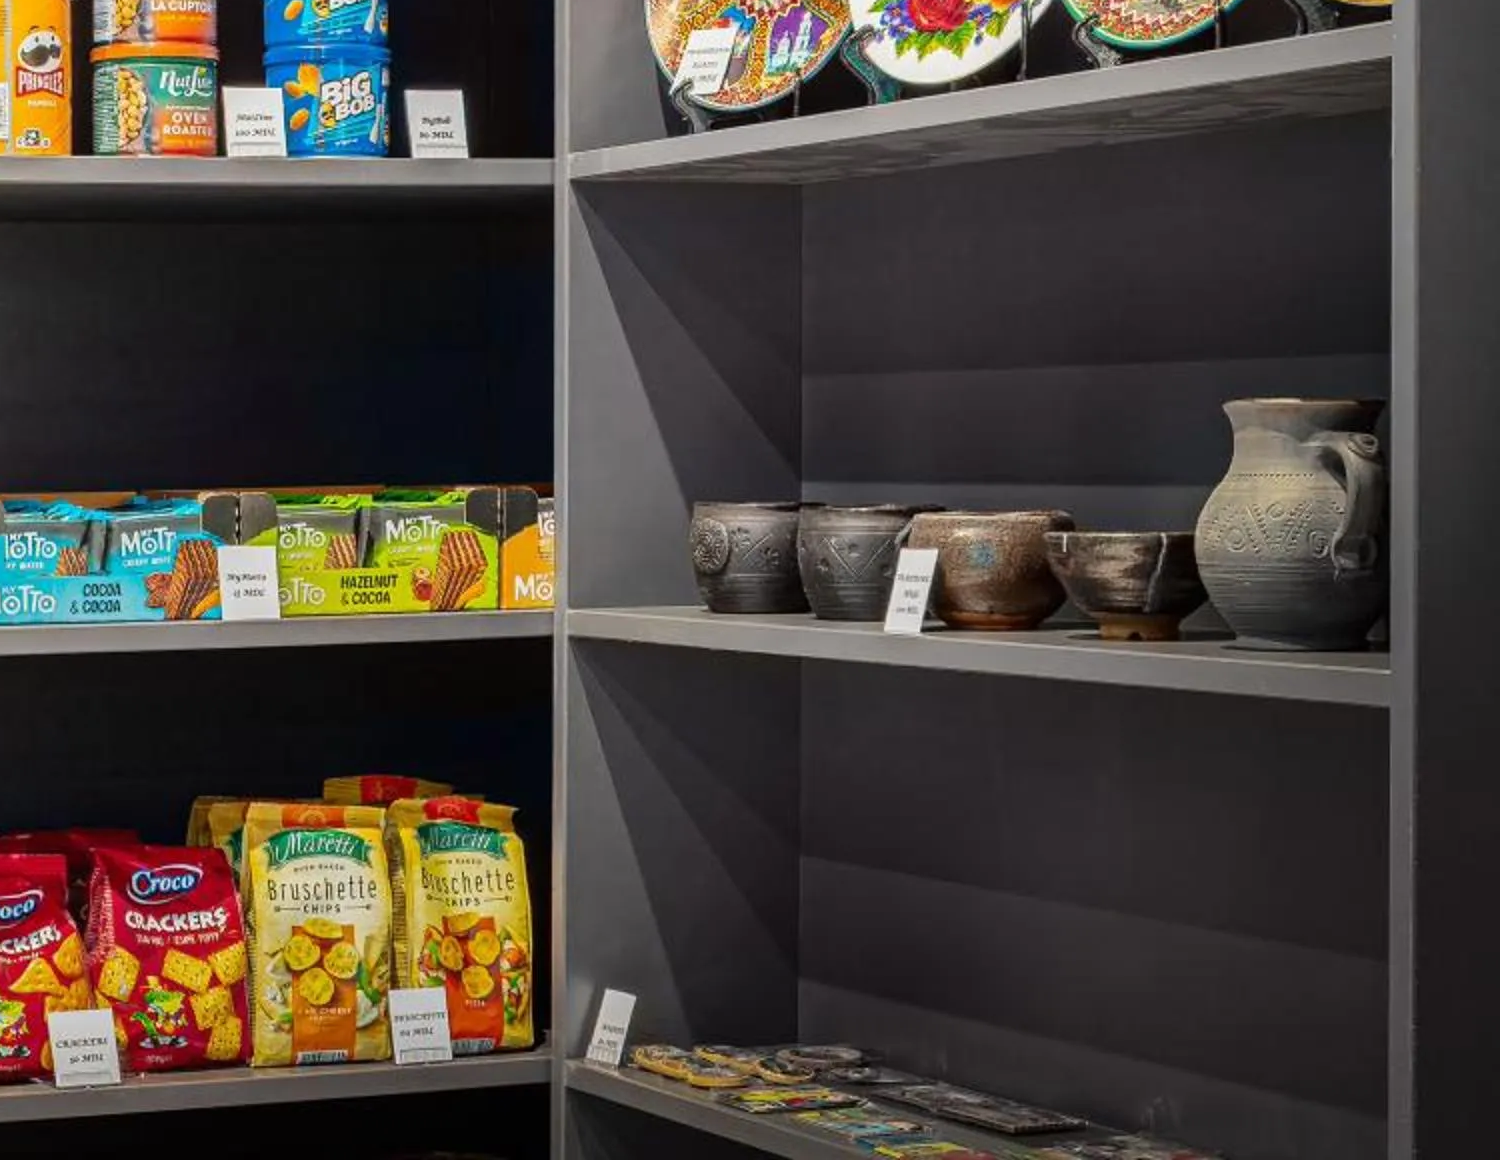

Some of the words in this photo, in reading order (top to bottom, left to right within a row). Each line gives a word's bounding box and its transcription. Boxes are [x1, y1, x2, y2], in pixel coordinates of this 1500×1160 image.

[150, 0, 166, 11] LA
[321, 71, 371, 106] BIG
[336, 93, 376, 121] BOB
[83, 583, 122, 597] COCOA
[340, 574, 398, 589] HAZELNUT
[69, 600, 79, 614] &
[82, 599, 121, 613] COCOA
[351, 590, 391, 605] COCOA
[276, 833, 357, 862] Maretti
[131, 869, 195, 896] Croco
[268, 876, 378, 902] Bruschette
[420, 868, 516, 893] Bruschette
[125, 905, 227, 932] CRACKERS
[303, 904, 342, 914] CHIPS
